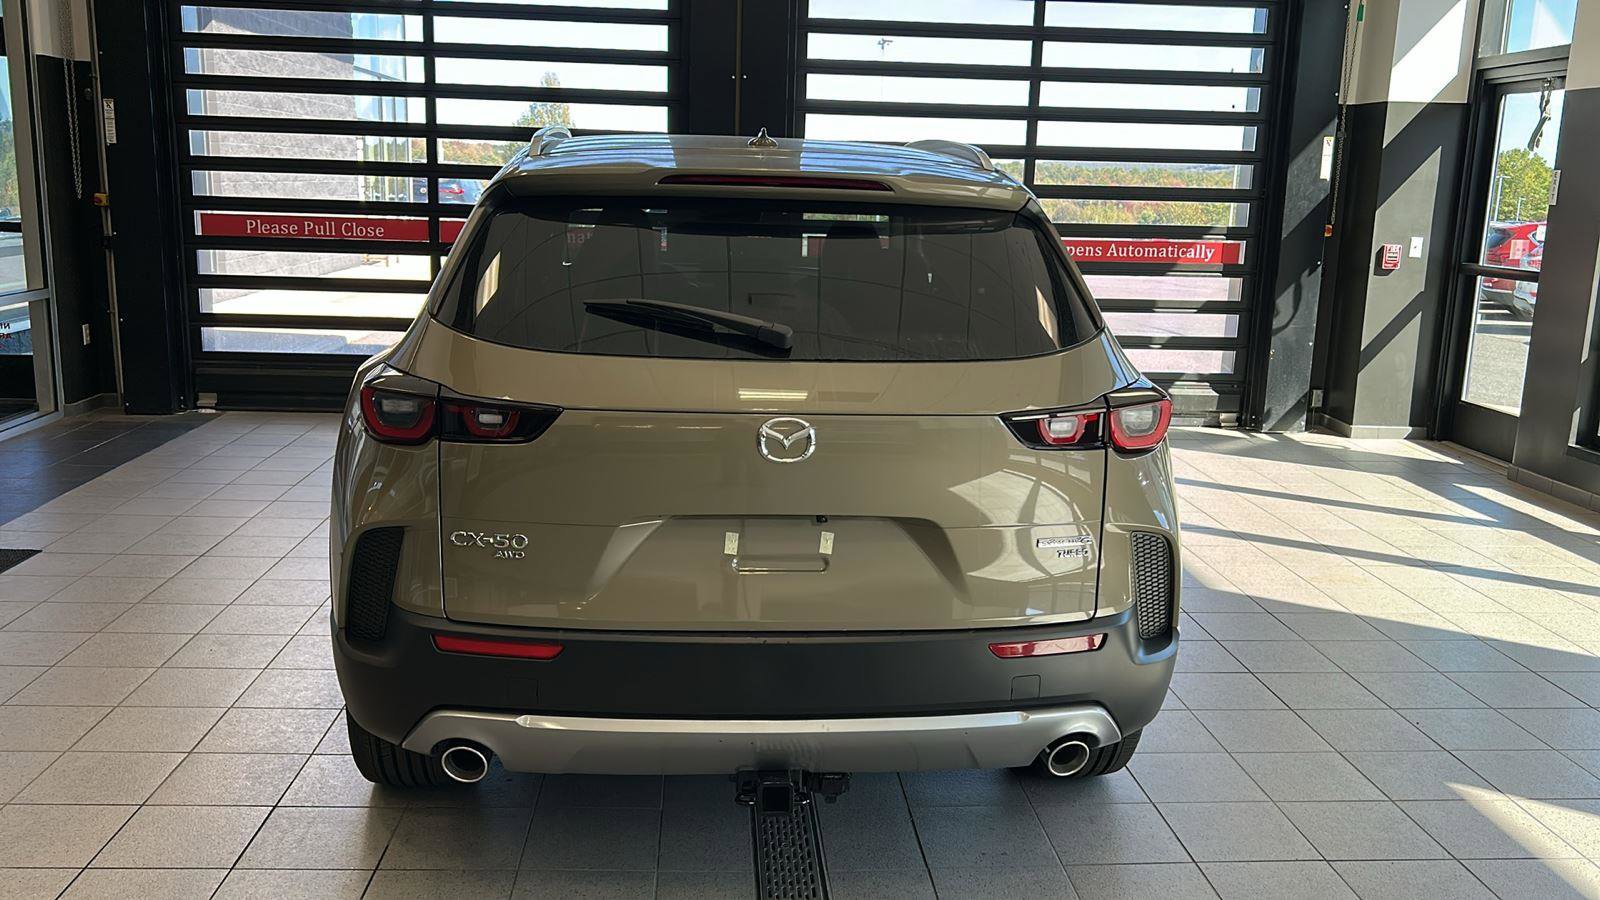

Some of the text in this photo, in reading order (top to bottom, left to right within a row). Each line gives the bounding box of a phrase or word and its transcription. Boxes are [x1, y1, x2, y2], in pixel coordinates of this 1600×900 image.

[246, 219, 385, 237] Please Pull Close
[1066, 243, 1215, 262] pens Automatically
[450, 530, 528, 549] CX-50
[494, 550, 525, 559] AWD
